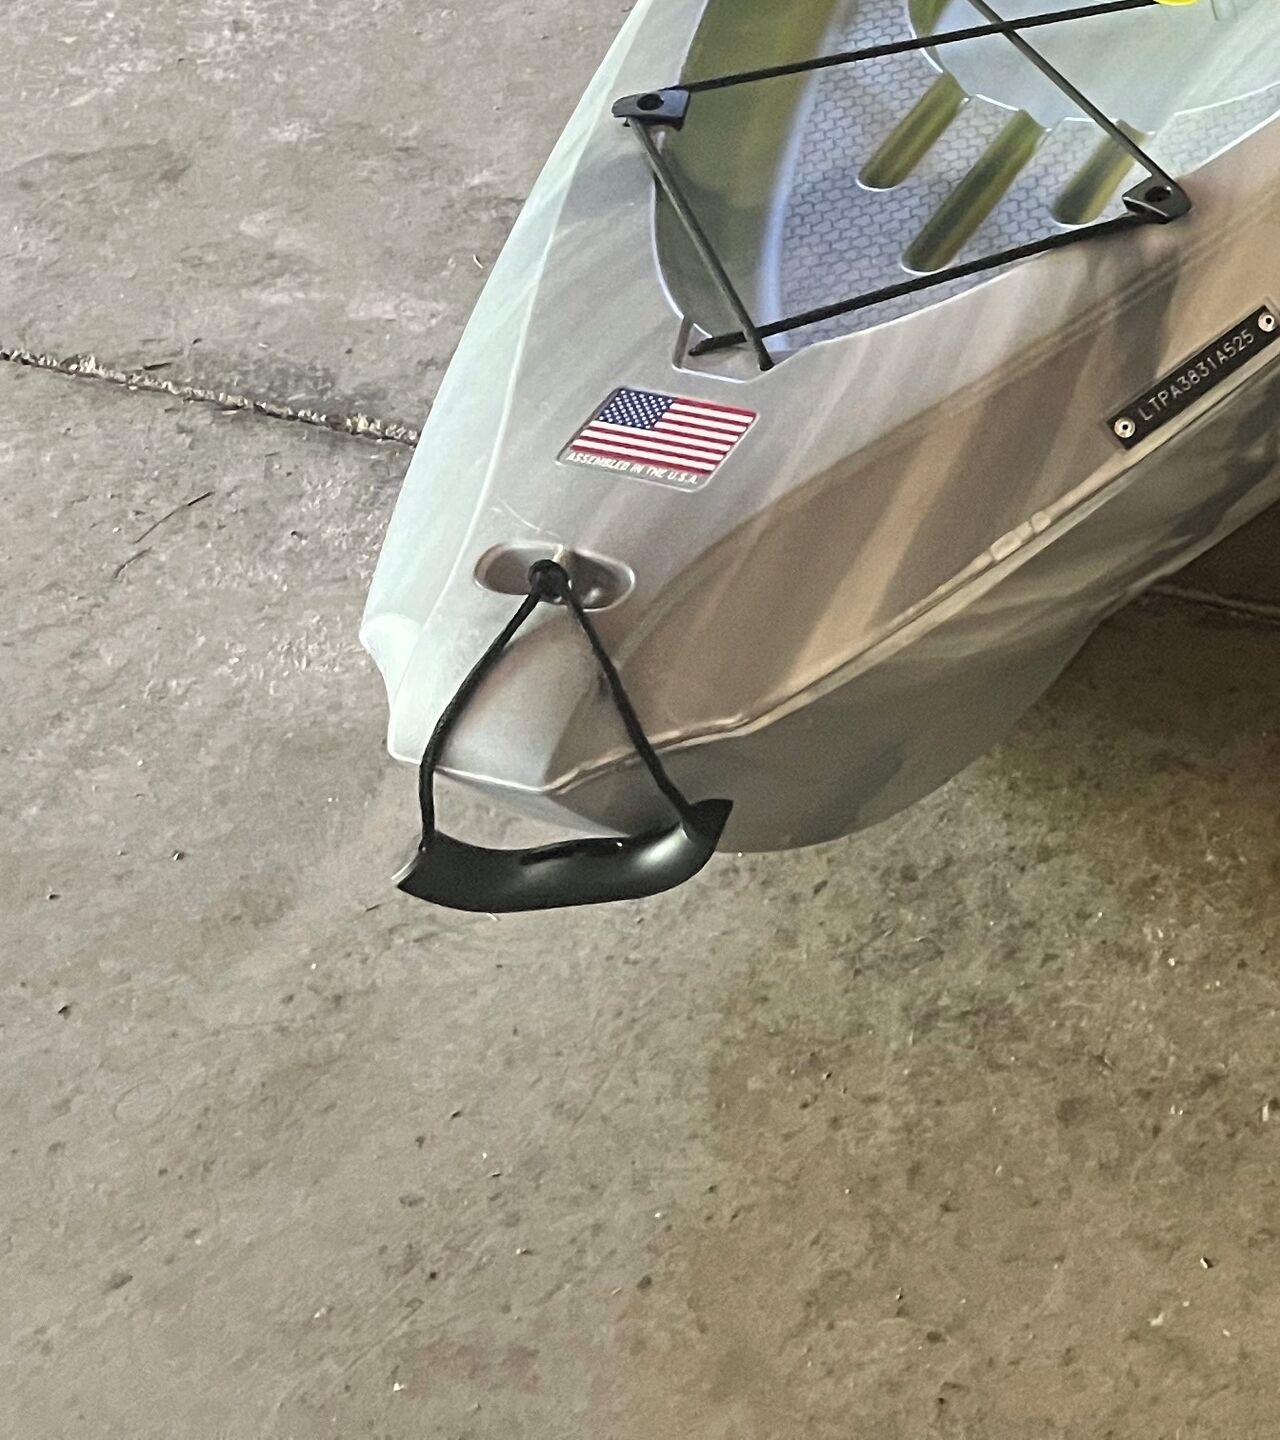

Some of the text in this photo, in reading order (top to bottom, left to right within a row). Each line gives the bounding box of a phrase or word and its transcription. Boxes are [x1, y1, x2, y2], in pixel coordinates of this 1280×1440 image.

[566, 452, 629, 471] ASSEMBLED
[630, 463, 643, 474] IN
[646, 466, 666, 479] THE
